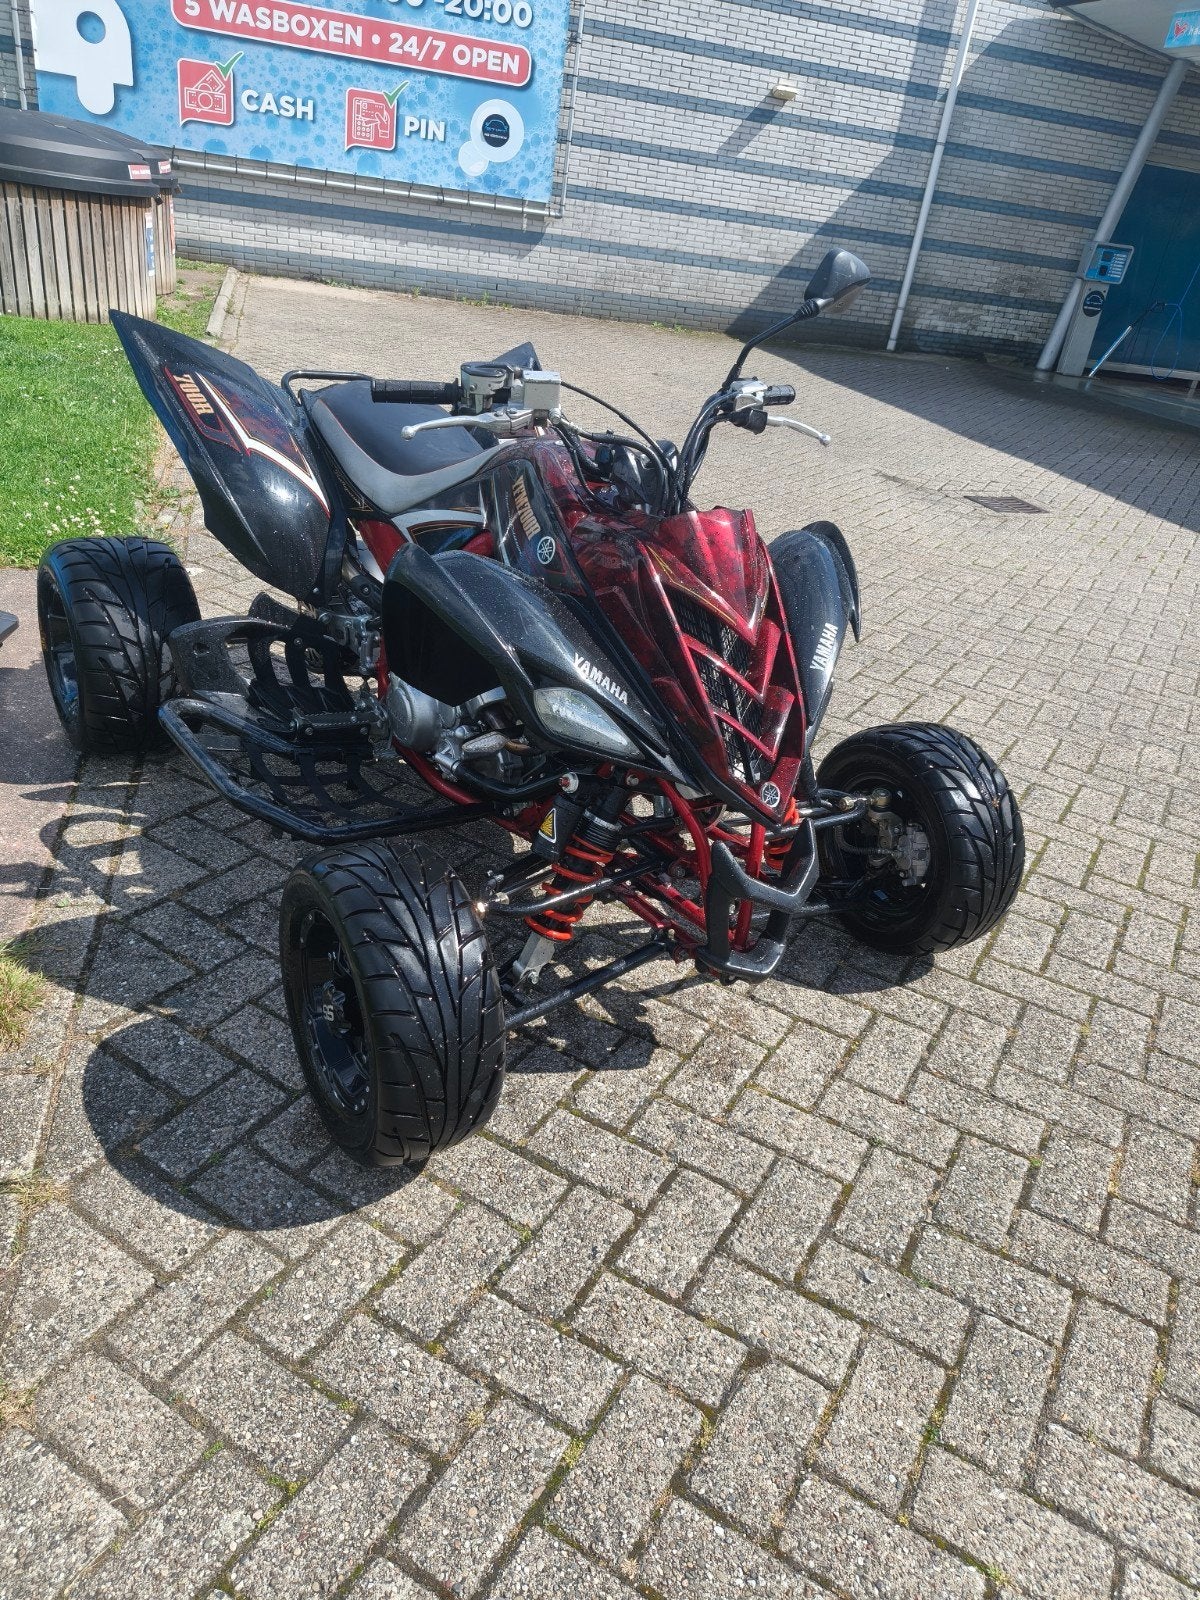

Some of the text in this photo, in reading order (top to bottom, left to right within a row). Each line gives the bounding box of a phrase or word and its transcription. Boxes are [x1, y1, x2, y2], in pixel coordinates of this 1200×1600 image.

[185, 0, 520, 75] 5 WASBOXEN 24/7 OPEN
[240, 89, 314, 121] CASH
[404, 116, 445, 142] PIN
[173, 374, 214, 415] 700R
[810, 622, 839, 671] YAMAHA
[573, 652, 628, 705] YAMAHA
